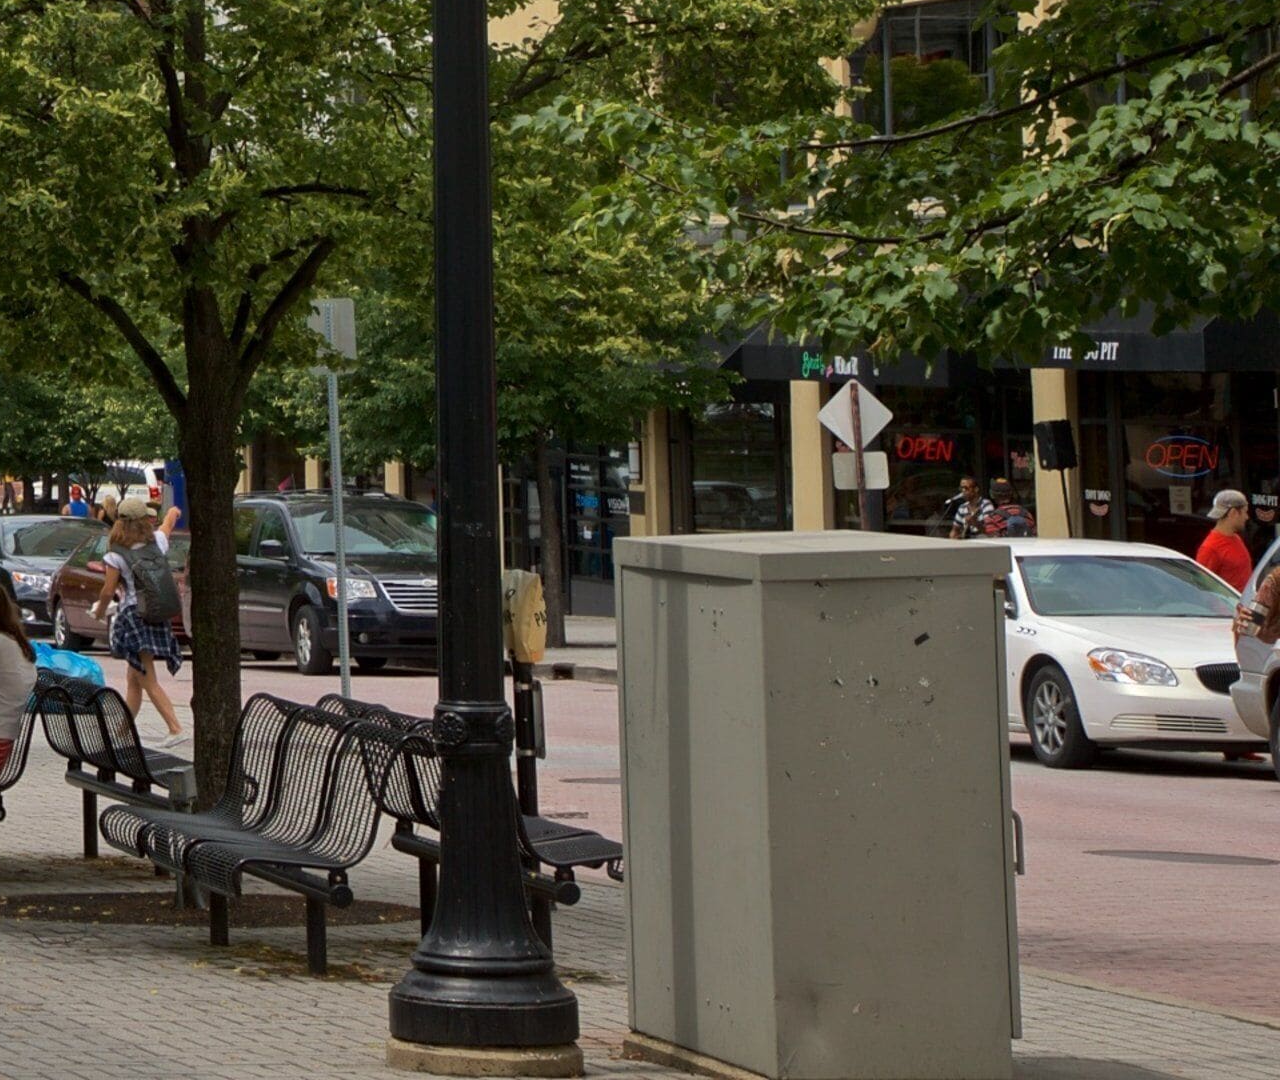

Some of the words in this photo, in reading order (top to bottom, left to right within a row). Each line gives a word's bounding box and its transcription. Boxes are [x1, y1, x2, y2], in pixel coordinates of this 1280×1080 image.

[1101, 342, 1119, 360] PIT
[897, 436, 954, 462] OPEN
[1145, 443, 1219, 469] OPEN
